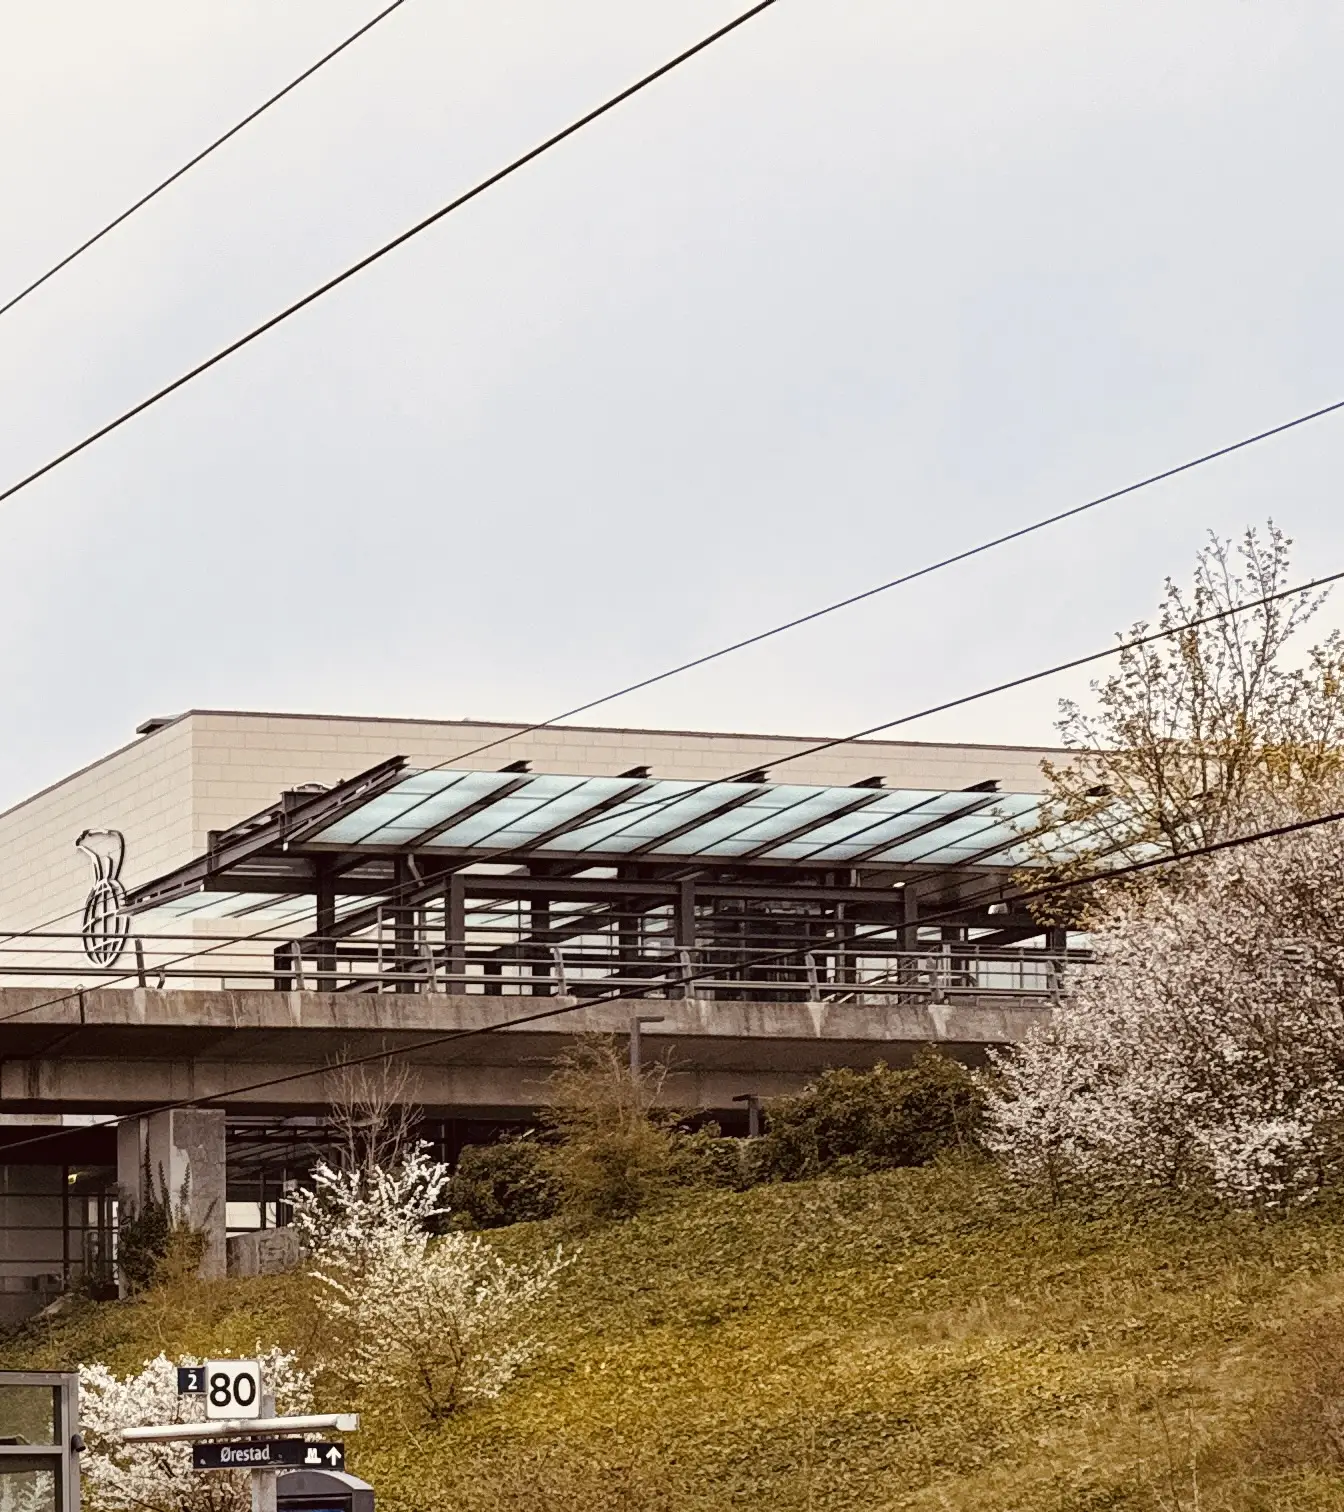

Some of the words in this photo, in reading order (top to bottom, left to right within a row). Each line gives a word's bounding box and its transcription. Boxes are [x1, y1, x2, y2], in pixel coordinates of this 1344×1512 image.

[187, 1374, 198, 1390] 2
[210, 1372, 256, 1407] 80
[220, 1444, 270, 1463] Ørestad
